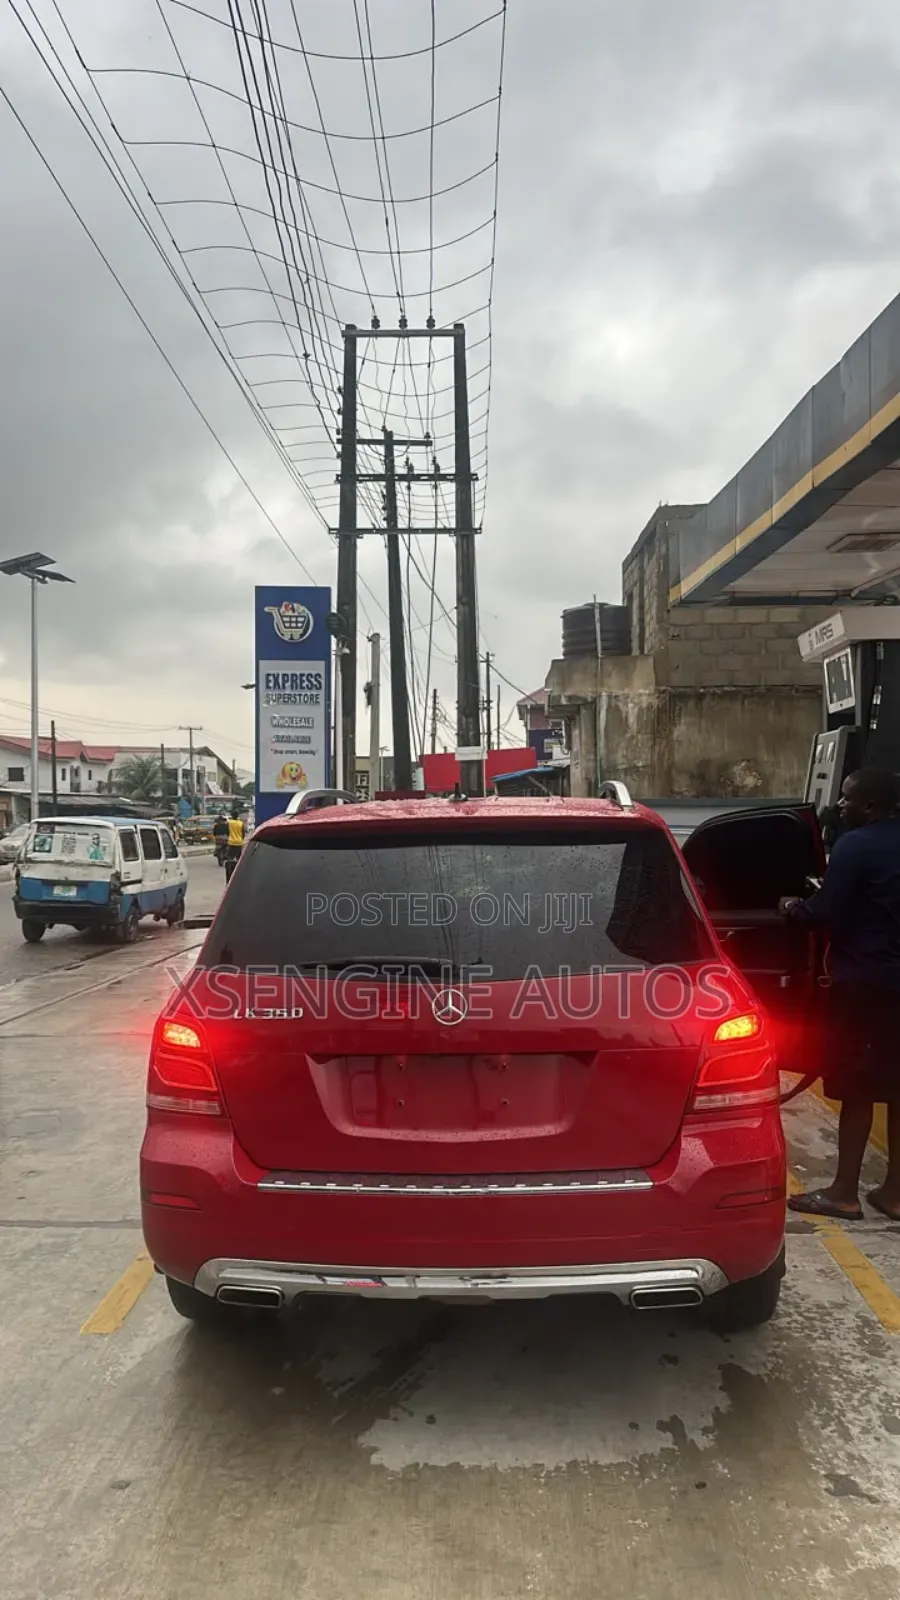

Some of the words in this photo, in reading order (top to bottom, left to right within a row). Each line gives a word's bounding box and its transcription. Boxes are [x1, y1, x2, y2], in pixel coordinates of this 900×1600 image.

[265, 673, 322, 690] EXPRESS
[265, 693, 320, 704] SUPERSTORE
[271, 716, 315, 728] WHOLESALE
[262, 1007, 304, 1019] 350
